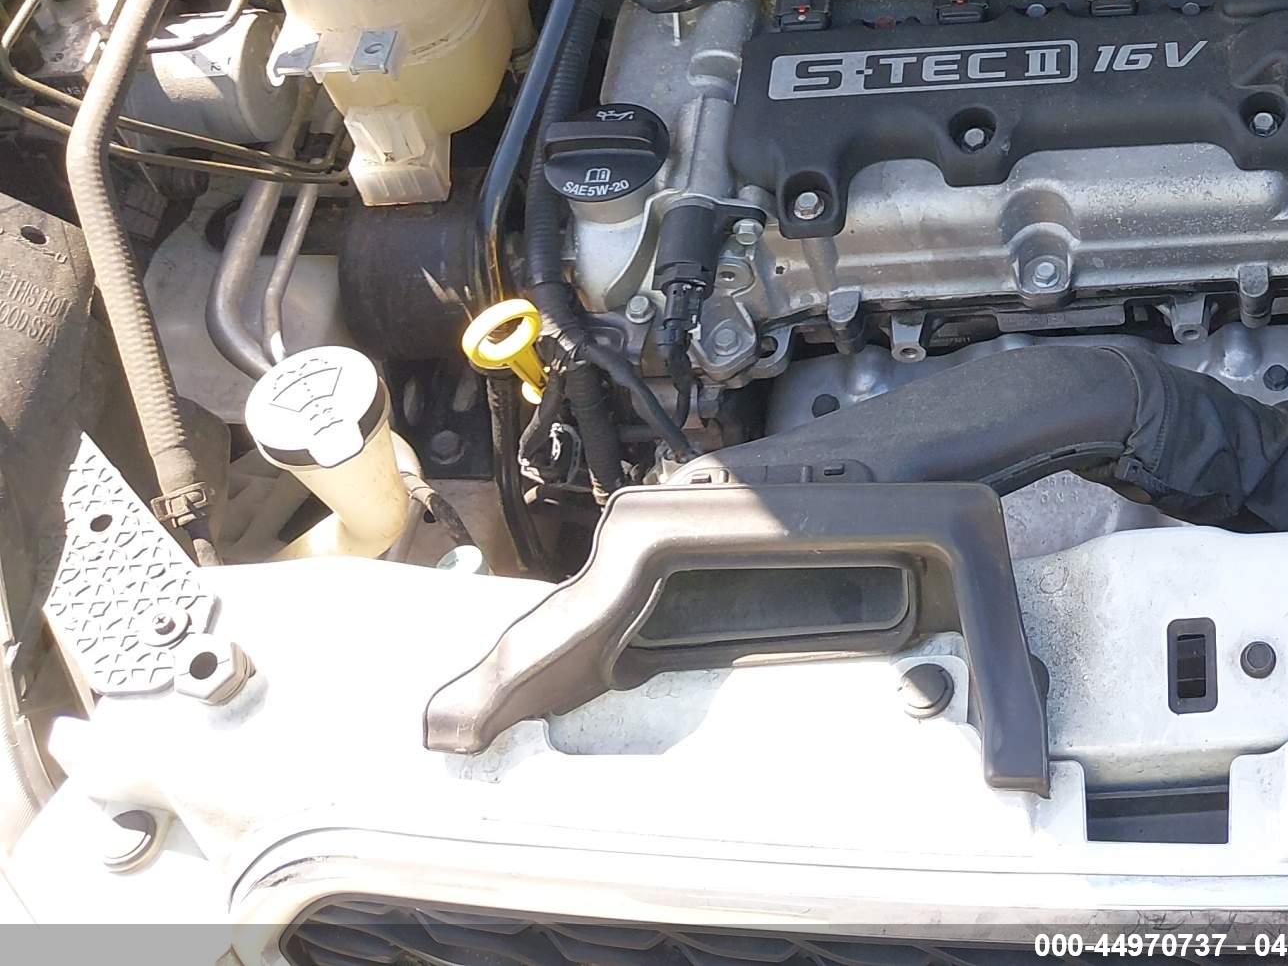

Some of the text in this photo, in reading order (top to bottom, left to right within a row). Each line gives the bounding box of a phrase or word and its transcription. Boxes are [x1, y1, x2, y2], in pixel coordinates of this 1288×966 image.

[1024, 48, 1062, 77] II
[1093, 40, 1208, 72] 16V
[562, 179, 630, 196] SAE5W-20
